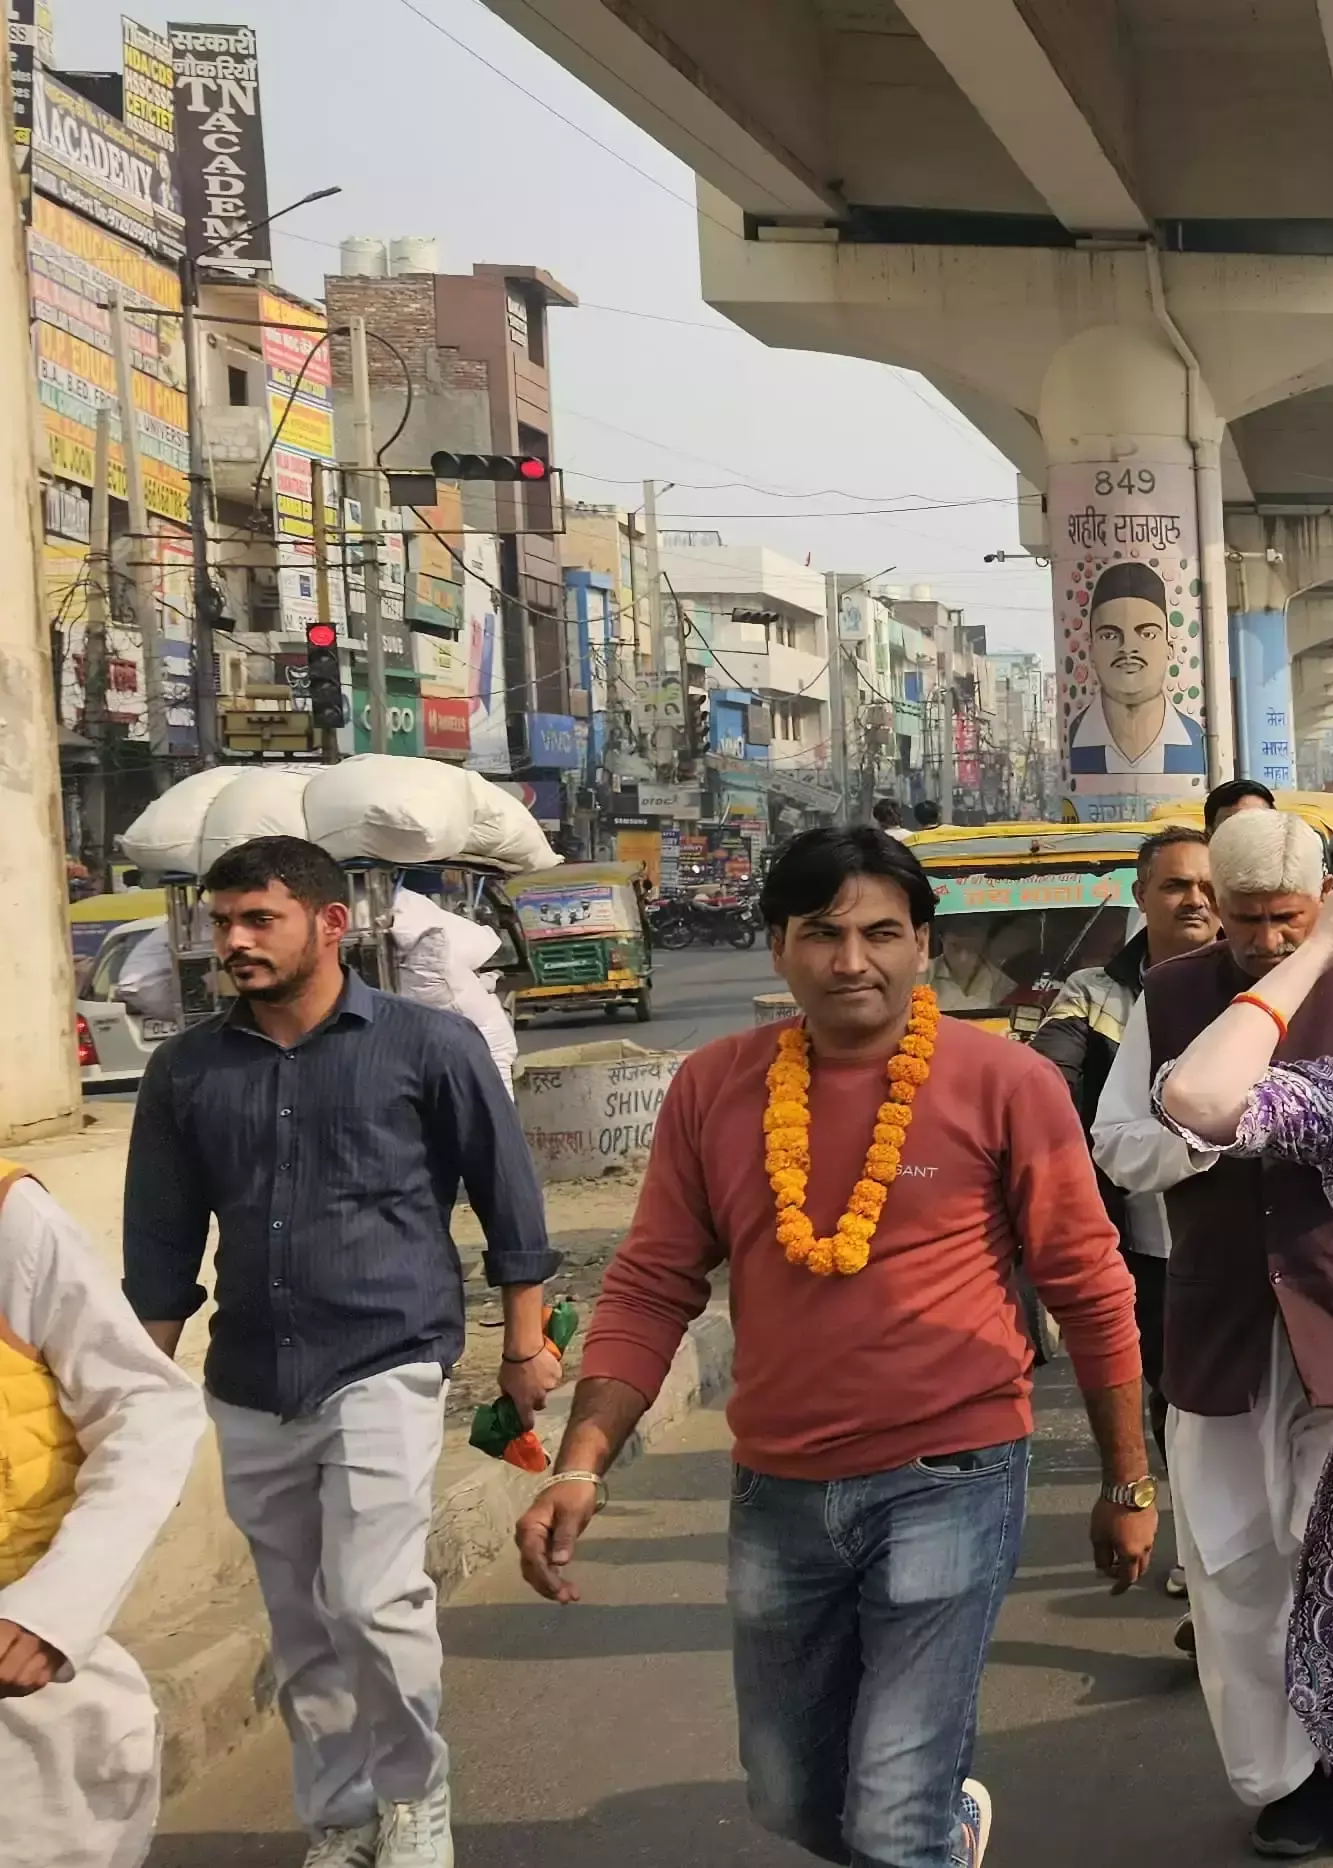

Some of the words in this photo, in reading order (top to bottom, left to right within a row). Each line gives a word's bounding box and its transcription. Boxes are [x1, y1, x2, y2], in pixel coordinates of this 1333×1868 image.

[172, 28, 255, 54] सरकारी
[176, 76, 257, 115] TN
[52, 107, 152, 203] ACADEMY
[198, 112, 253, 258] ACADEMY
[1095, 468, 1155, 495] 849
[1068, 505, 1107, 548] शहीद
[1114, 514, 1180, 550] राजगुरु
[614, 817, 648, 825] SAMSUNG
[600, 1123, 652, 1155] OPTIC
